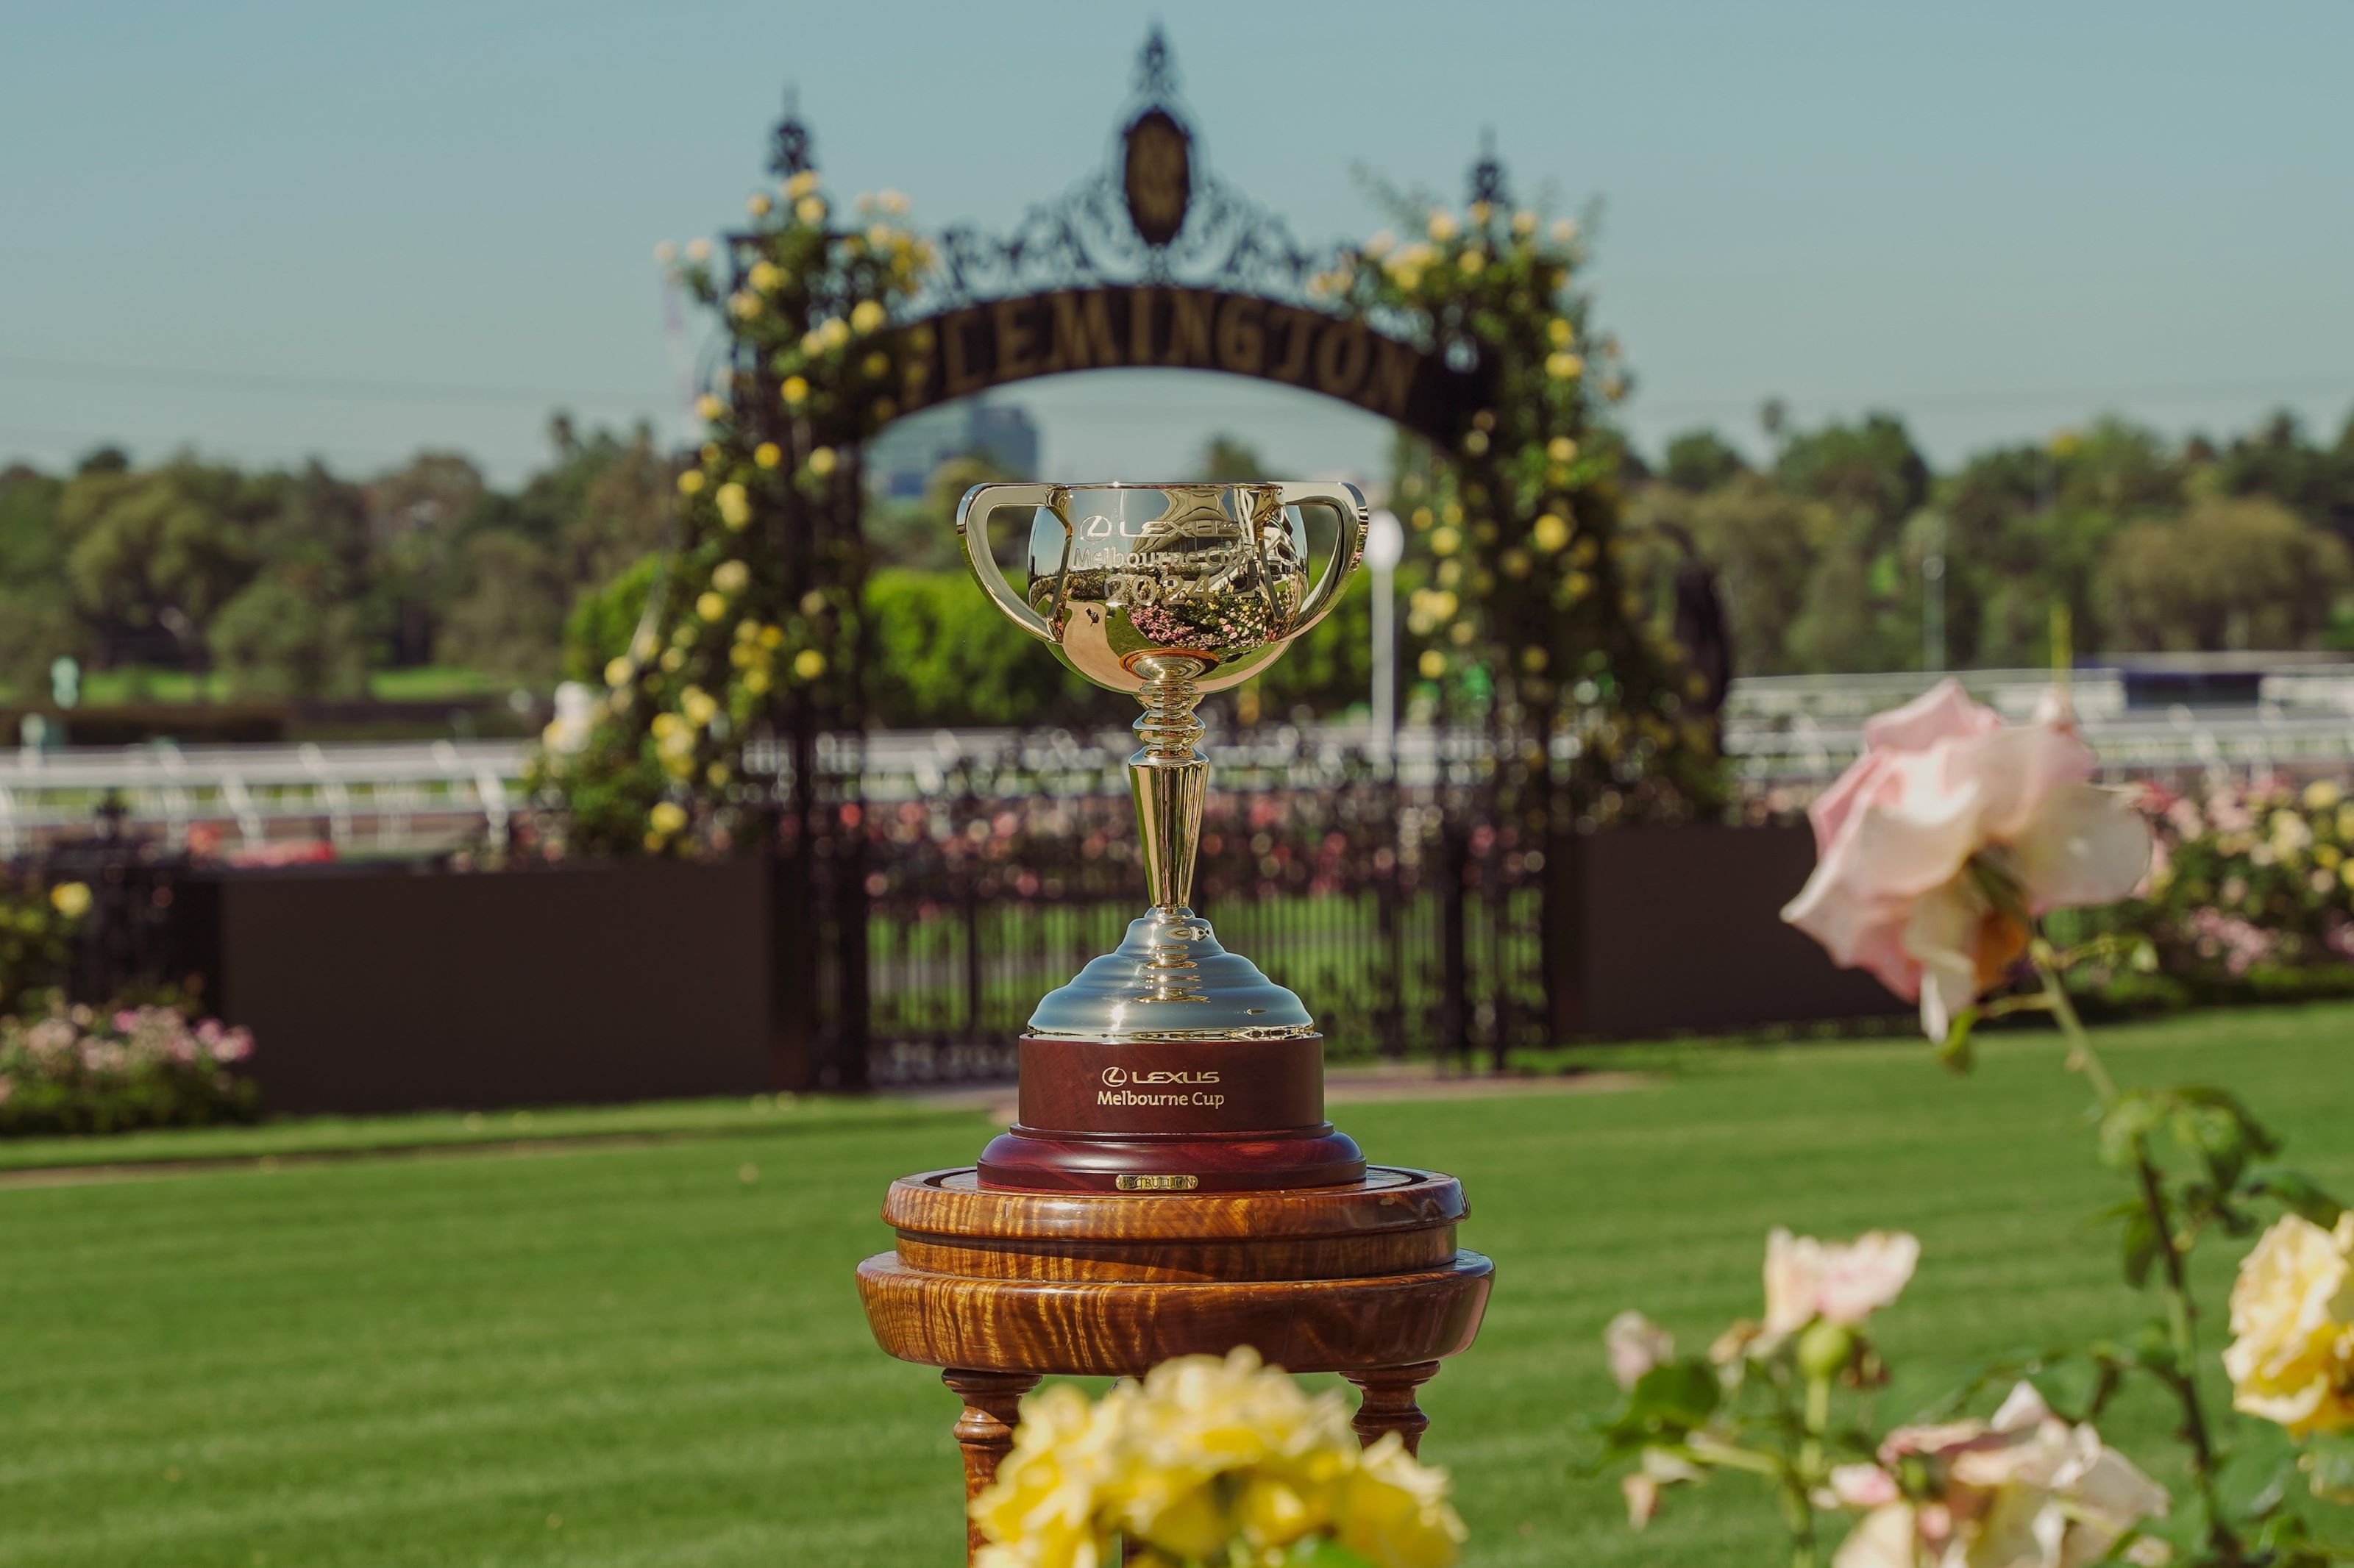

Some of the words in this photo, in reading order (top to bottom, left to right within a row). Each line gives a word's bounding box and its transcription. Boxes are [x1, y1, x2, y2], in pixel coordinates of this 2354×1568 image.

[1120, 521, 1242, 538] LEXUS
[1073, 547, 1199, 570] Melbourne
[1204, 547, 1249, 576] Cup
[1105, 574, 1213, 607] 2024
[1132, 1072, 1220, 1084] LEXUS
[1097, 1090, 1188, 1105] Melbourne
[1192, 1091, 1225, 1109] Cup
